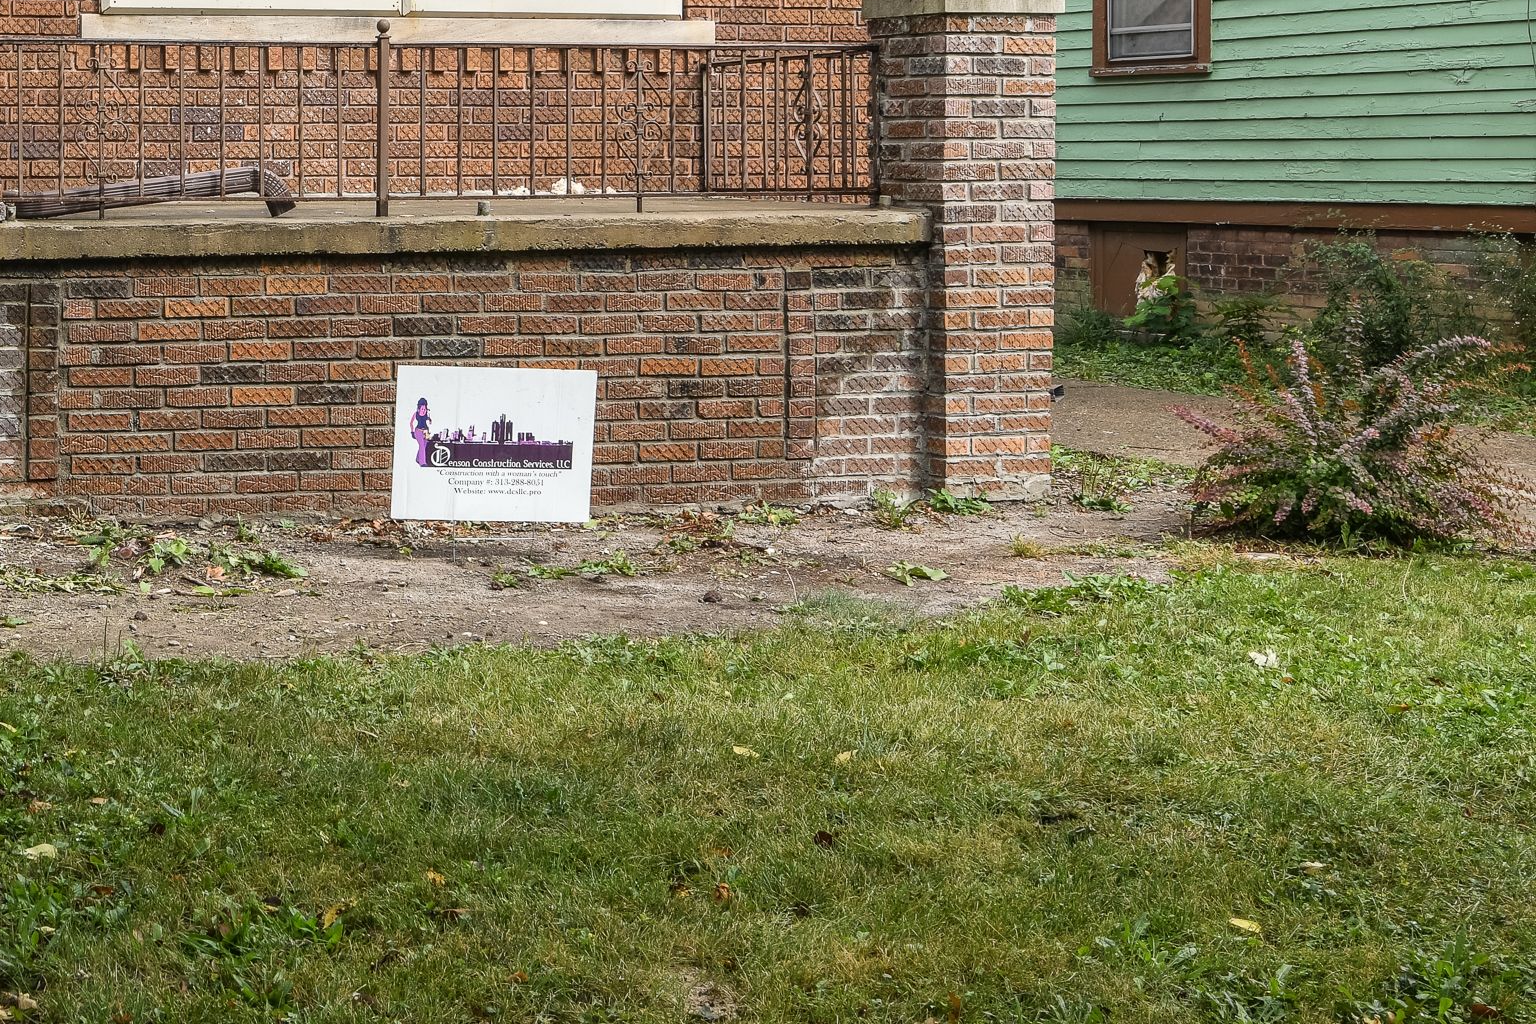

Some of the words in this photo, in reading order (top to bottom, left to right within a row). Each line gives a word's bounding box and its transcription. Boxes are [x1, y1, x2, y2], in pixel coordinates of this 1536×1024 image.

[472, 458, 521, 468] Construction
[556, 459, 571, 469] LLC
[485, 469, 500, 477] with
[448, 477, 483, 487] Company
[454, 487, 486, 495] Website:
